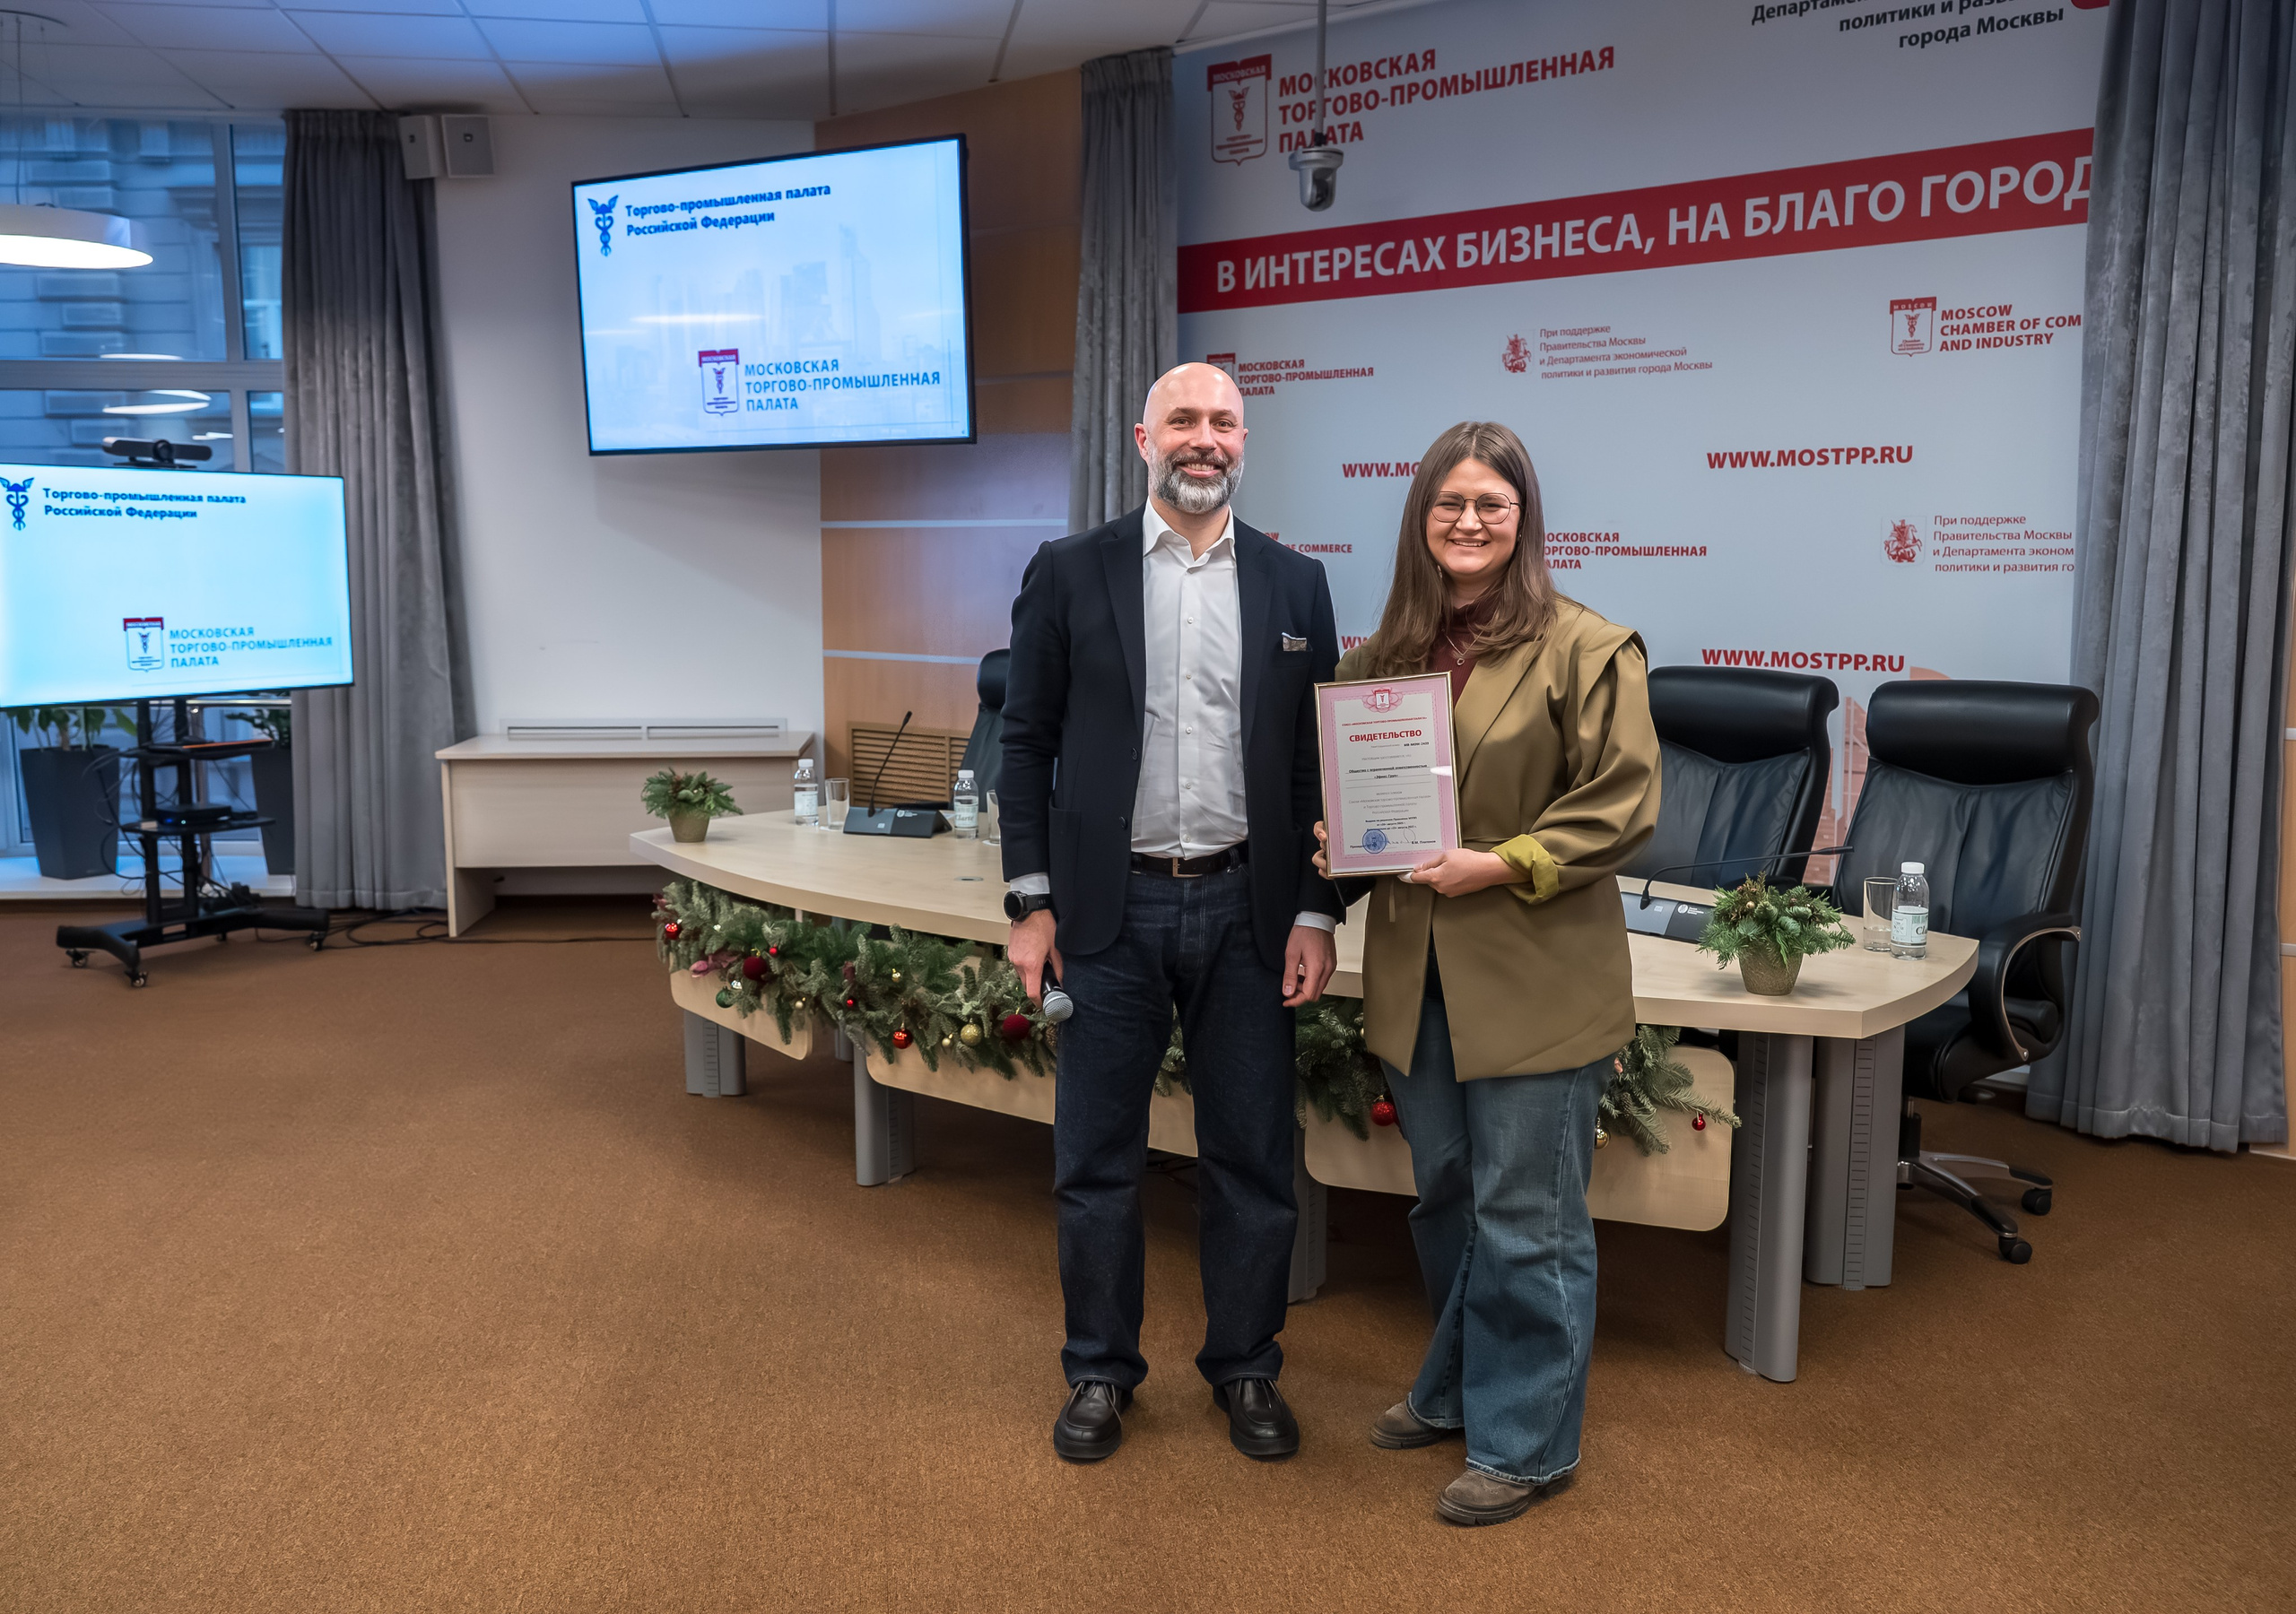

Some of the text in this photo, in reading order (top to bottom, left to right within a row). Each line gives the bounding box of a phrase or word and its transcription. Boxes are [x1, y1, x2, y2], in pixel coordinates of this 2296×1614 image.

[1751, 0, 1866, 25] Департам
[1839, 3, 1936, 31] политики
[1940, 0, 1953, 13] и
[1899, 8, 2065, 48] города Москвы
[1279, 46, 1615, 126] ТОРГОВО-ПРОМЫШЛЕННАЯ
[625, 183, 831, 218] Торгово-промышленная палата
[627, 210, 776, 237] Российской Федерации
[1217, 154, 2093, 293] В ИНТЕРЕСАХ БИЗНЕСА, НА БЛАГО ГОРОД
[1941, 304, 2013, 321] MOSCOW
[1540, 325, 1611, 339] При поддержке
[1940, 315, 2082, 337] CHAMBER OF COM
[1540, 337, 1646, 352] Правительства Москвы
[1939, 339, 1972, 351] AND
[1976, 333, 2054, 350] INDUSTRY
[1239, 360, 1305, 372] МОСКОВСКАЯ
[1547, 354, 1611, 368] Департамента
[1613, 347, 1687, 361] экономической
[744, 359, 839, 377] МОСКОВСКАЯ
[1239, 367, 1374, 384] ТОРГОВО-ПРОМЫШЛЕННАЯ
[1541, 370, 1584, 379] политики
[1594, 368, 1636, 378] развития
[1638, 365, 1671, 375] города
[1674, 360, 1713, 370] Москвы
[745, 370, 941, 395] ТОРГОВО-ПРОМЫШЛЕННАЯ
[746, 397, 798, 412] ПАЛАТА
[1707, 445, 1914, 470] WWW.MOSTPP.RU
[43, 488, 247, 505] Торгово-промышленная палата
[44, 505, 197, 520] Российской Федерации
[1934, 515, 2026, 527] При поддержке
[1544, 532, 1620, 542] ОСКОВСКАЯ
[1934, 530, 2073, 543] Правительства Москвы
[1299, 544, 1352, 553] COMMERCE
[1544, 546, 1707, 557] ОРГОВО-ПРОМЫШЛЕННАЯ
[1933, 546, 2074, 559] и Департамента эконом
[1545, 560, 1582, 569] АЛАТА
[1935, 564, 1990, 572] политики
[2004, 563, 2058, 574] развития
[170, 627, 254, 640] МОСКОВСКАЯ
[170, 637, 333, 654] ТОРГОВО-ПРОМЫШЛЕННАЯ
[171, 656, 219, 668] ПАЛАТА
[1701, 648, 1905, 673] WWW.MOSTPP.RU
[1349, 729, 1422, 742] СВИДЕТЕЛЬСТВО
